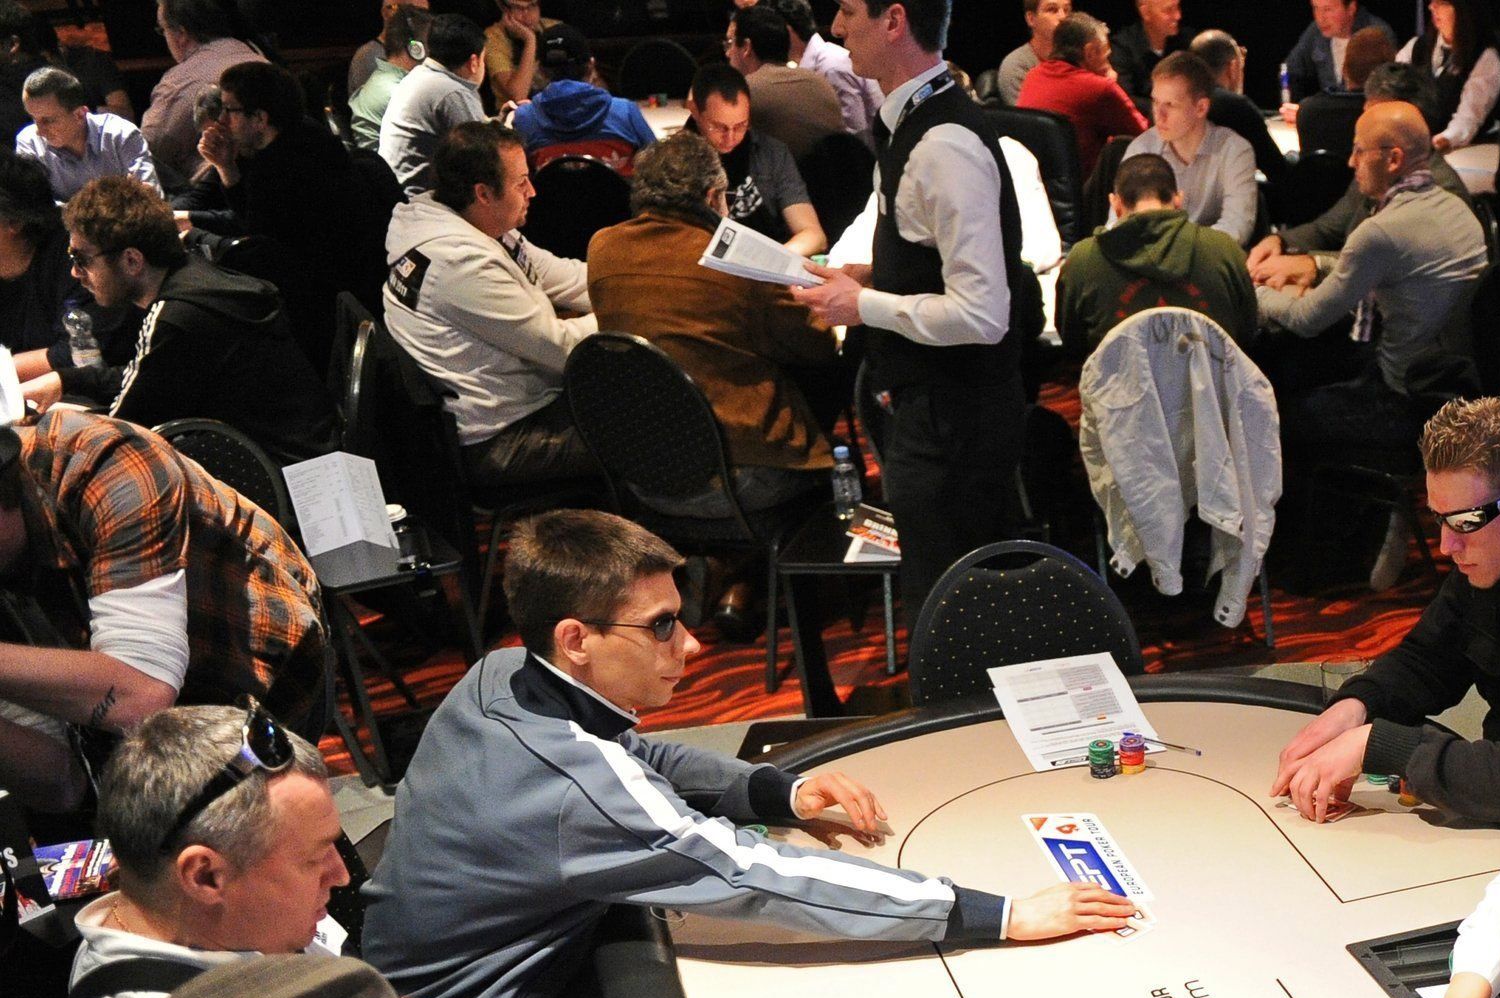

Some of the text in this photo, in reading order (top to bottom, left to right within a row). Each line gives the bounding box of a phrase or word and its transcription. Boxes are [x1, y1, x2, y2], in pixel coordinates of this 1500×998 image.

[1082, 818, 1144, 895] EUROPEAN POKER TOUR
